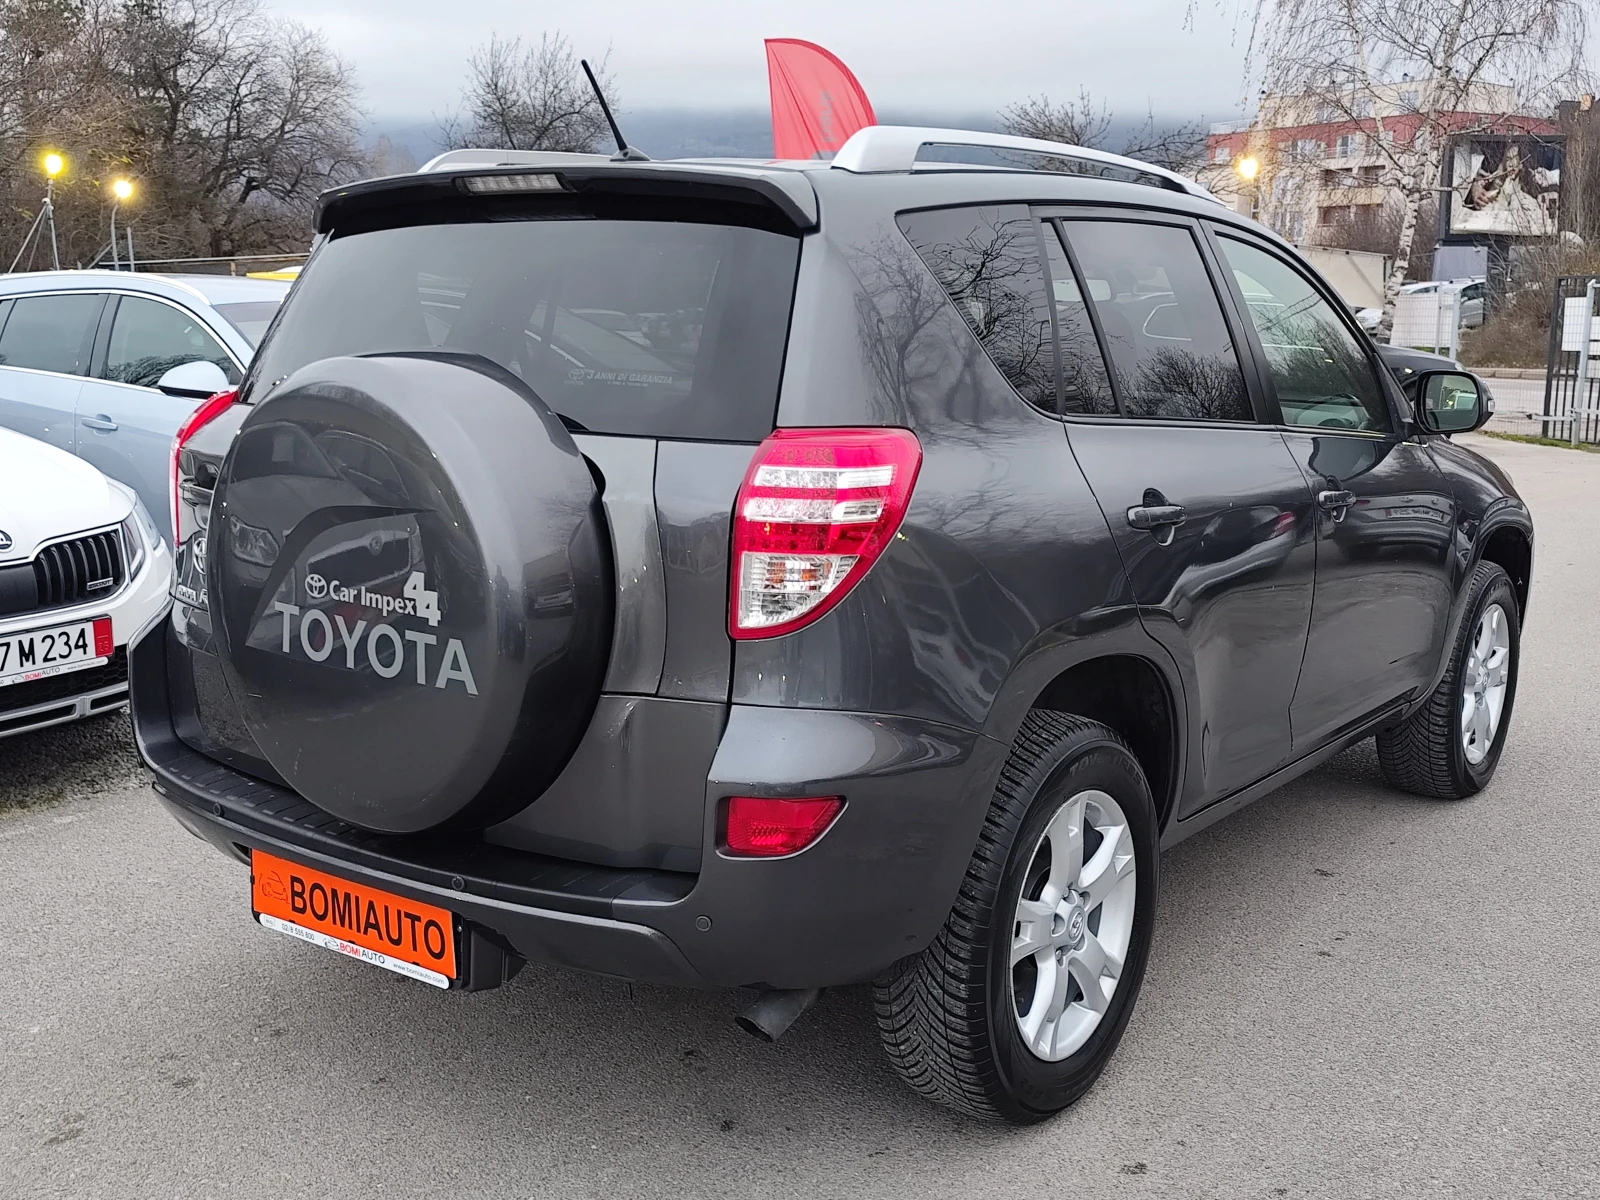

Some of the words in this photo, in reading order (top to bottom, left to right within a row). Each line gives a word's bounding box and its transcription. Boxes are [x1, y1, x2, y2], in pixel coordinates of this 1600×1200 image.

[594, 372, 617, 380] ANNI
[629, 374, 673, 384] GARANZIA
[329, 580, 356, 603] Car
[361, 586, 417, 617] Impex
[274, 601, 479, 696] TOYOTA
[290, 875, 446, 960] BOMIAUTO
[393, 963, 445, 984] www.bomiauto.com
